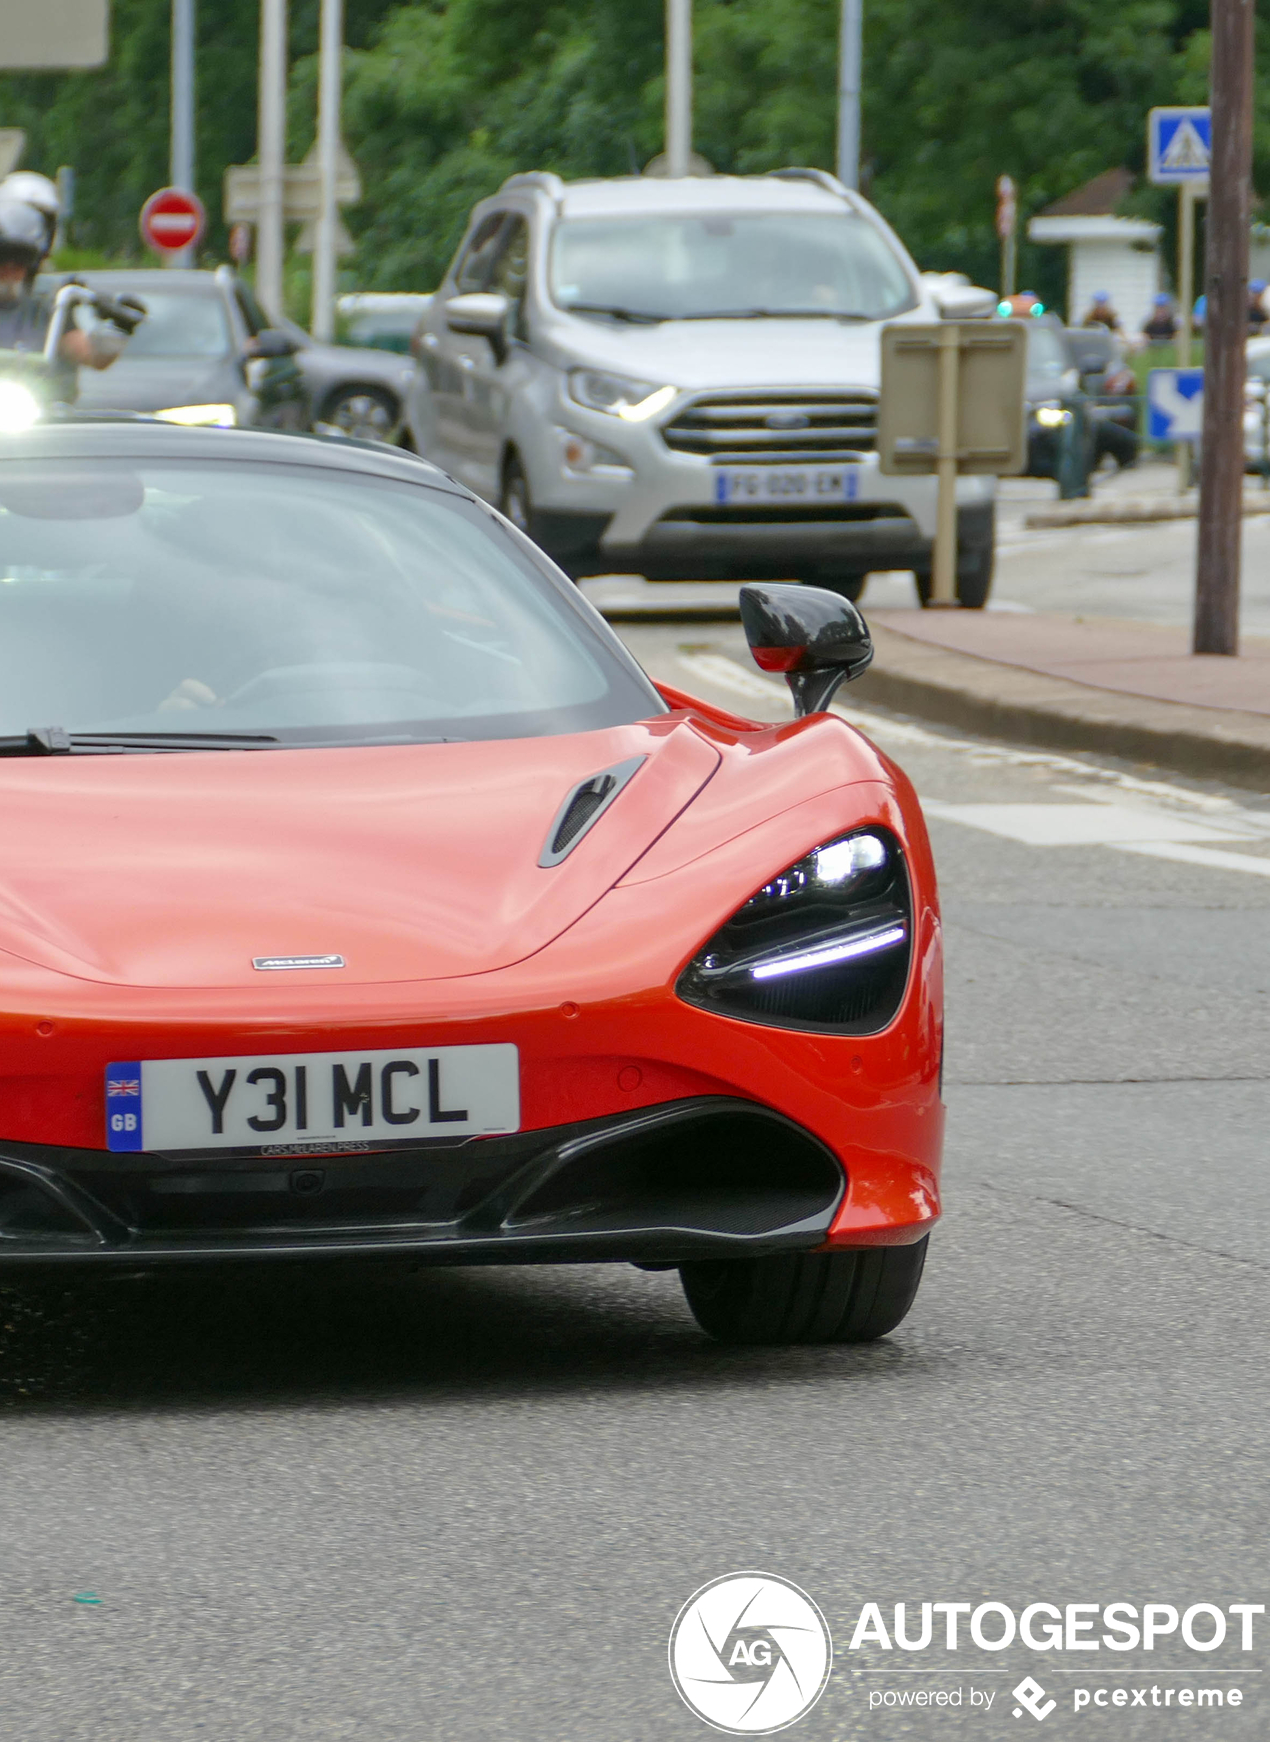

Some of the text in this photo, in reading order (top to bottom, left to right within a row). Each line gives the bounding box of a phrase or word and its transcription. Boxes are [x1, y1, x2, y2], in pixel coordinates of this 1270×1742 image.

[261, 957, 334, 967] McLaren
[197, 1059, 468, 1134] Y31 MCL
[111, 1113, 137, 1132] GB
